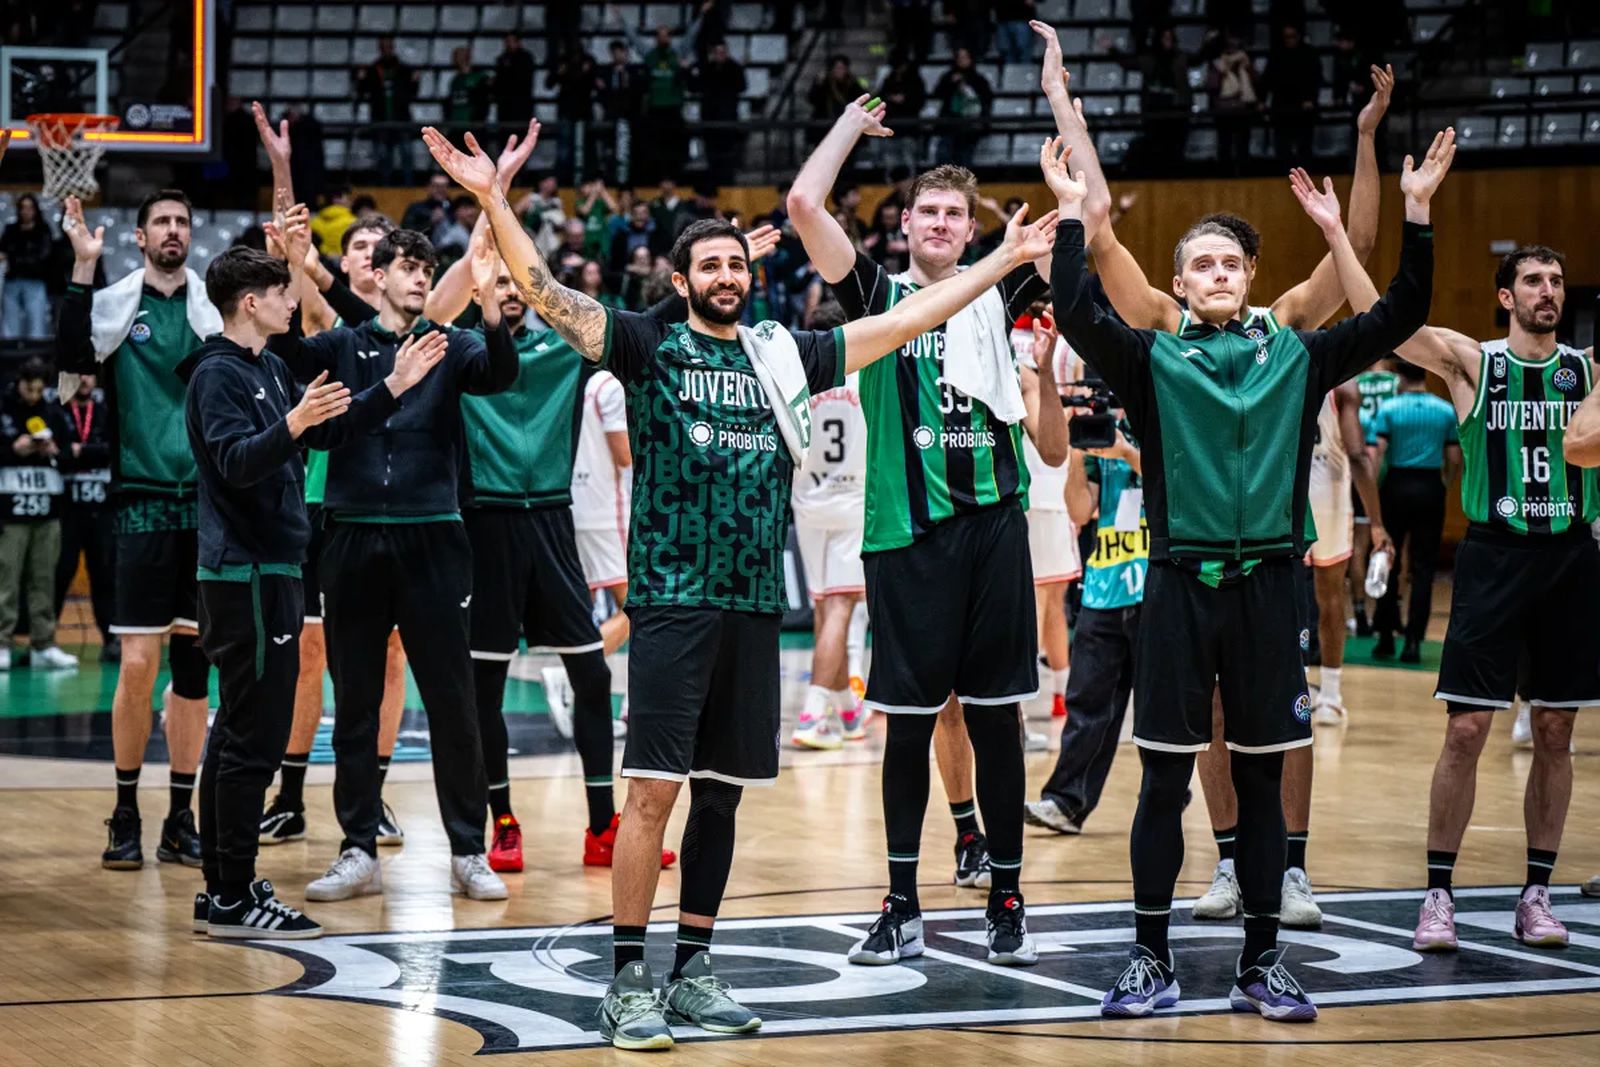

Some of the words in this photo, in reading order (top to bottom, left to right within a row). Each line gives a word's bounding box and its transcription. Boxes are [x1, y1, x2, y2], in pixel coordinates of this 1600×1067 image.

[1486, 400, 1580, 431] JOVENTU
[718, 430, 777, 451] PROBITAS
[823, 418, 845, 463] 3
[939, 431, 996, 448] PROBITAS
[1520, 446, 1551, 483] 16
[1521, 502, 1577, 518] PROBITA
